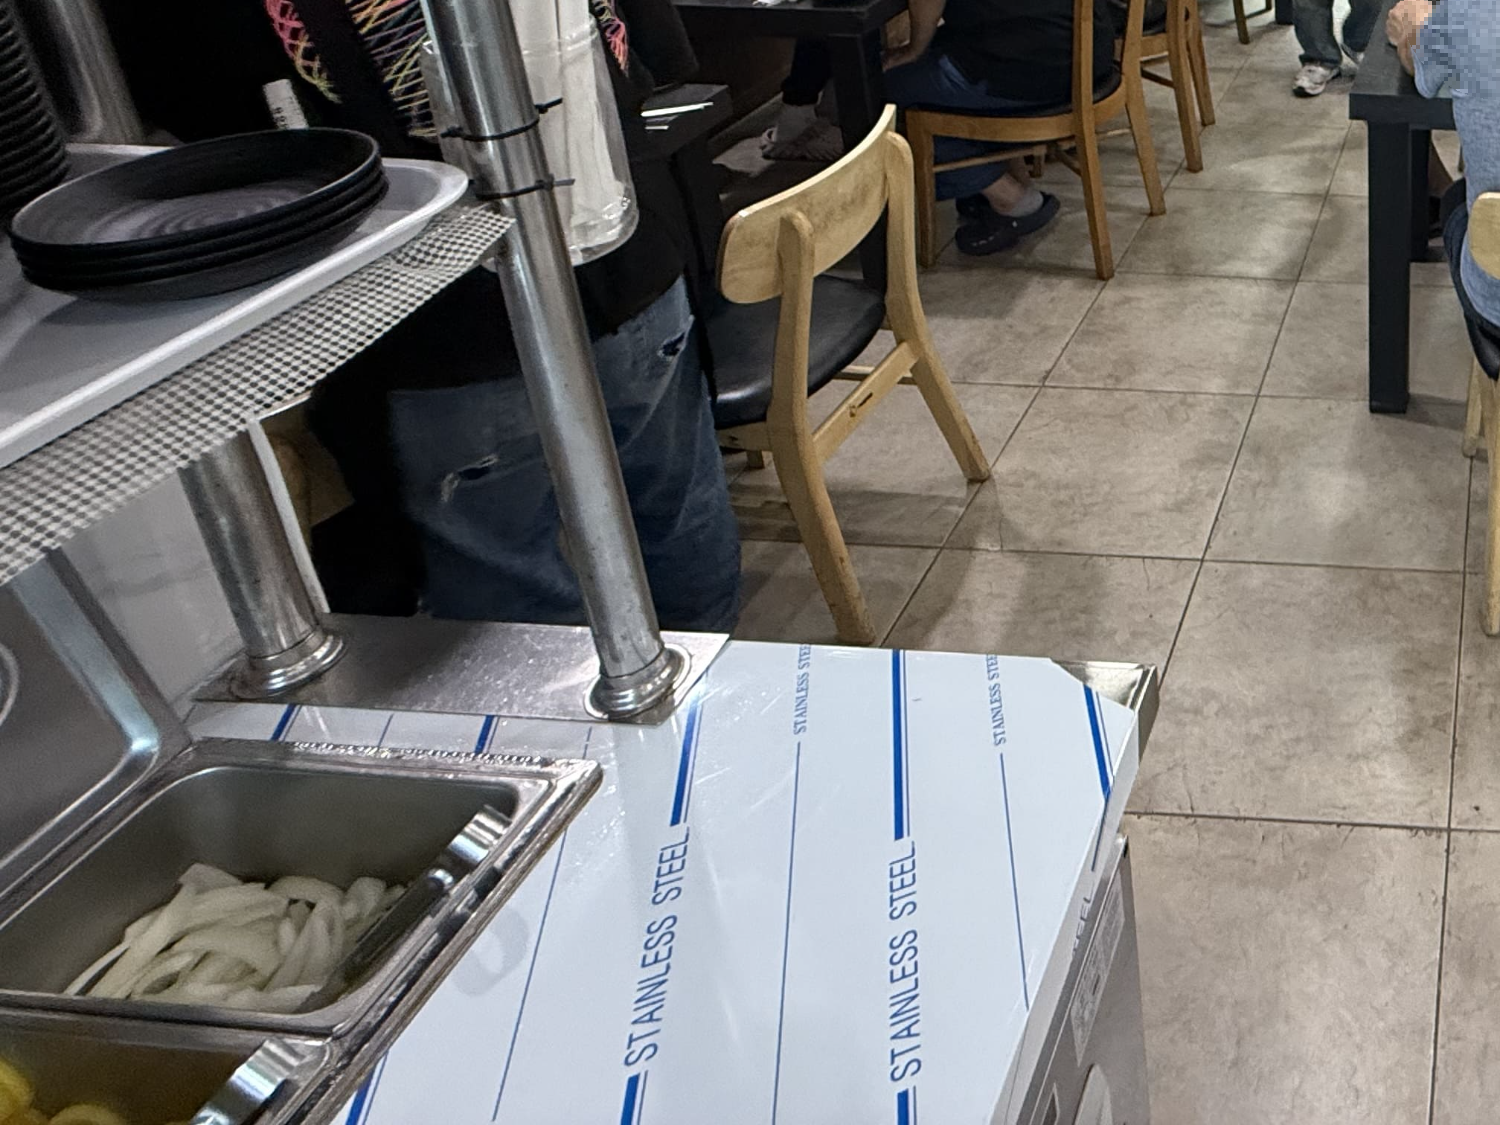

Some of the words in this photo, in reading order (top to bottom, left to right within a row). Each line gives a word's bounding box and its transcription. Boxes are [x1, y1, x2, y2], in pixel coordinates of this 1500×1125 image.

[793, 671, 810, 735] STAINLESS
[988, 682, 1006, 747] STAINLESS
[889, 840, 917, 921] STEEL
[624, 914, 678, 1067] STAINLESS
[651, 825, 690, 906] STEEL
[889, 928, 922, 1083] STAINLESS
